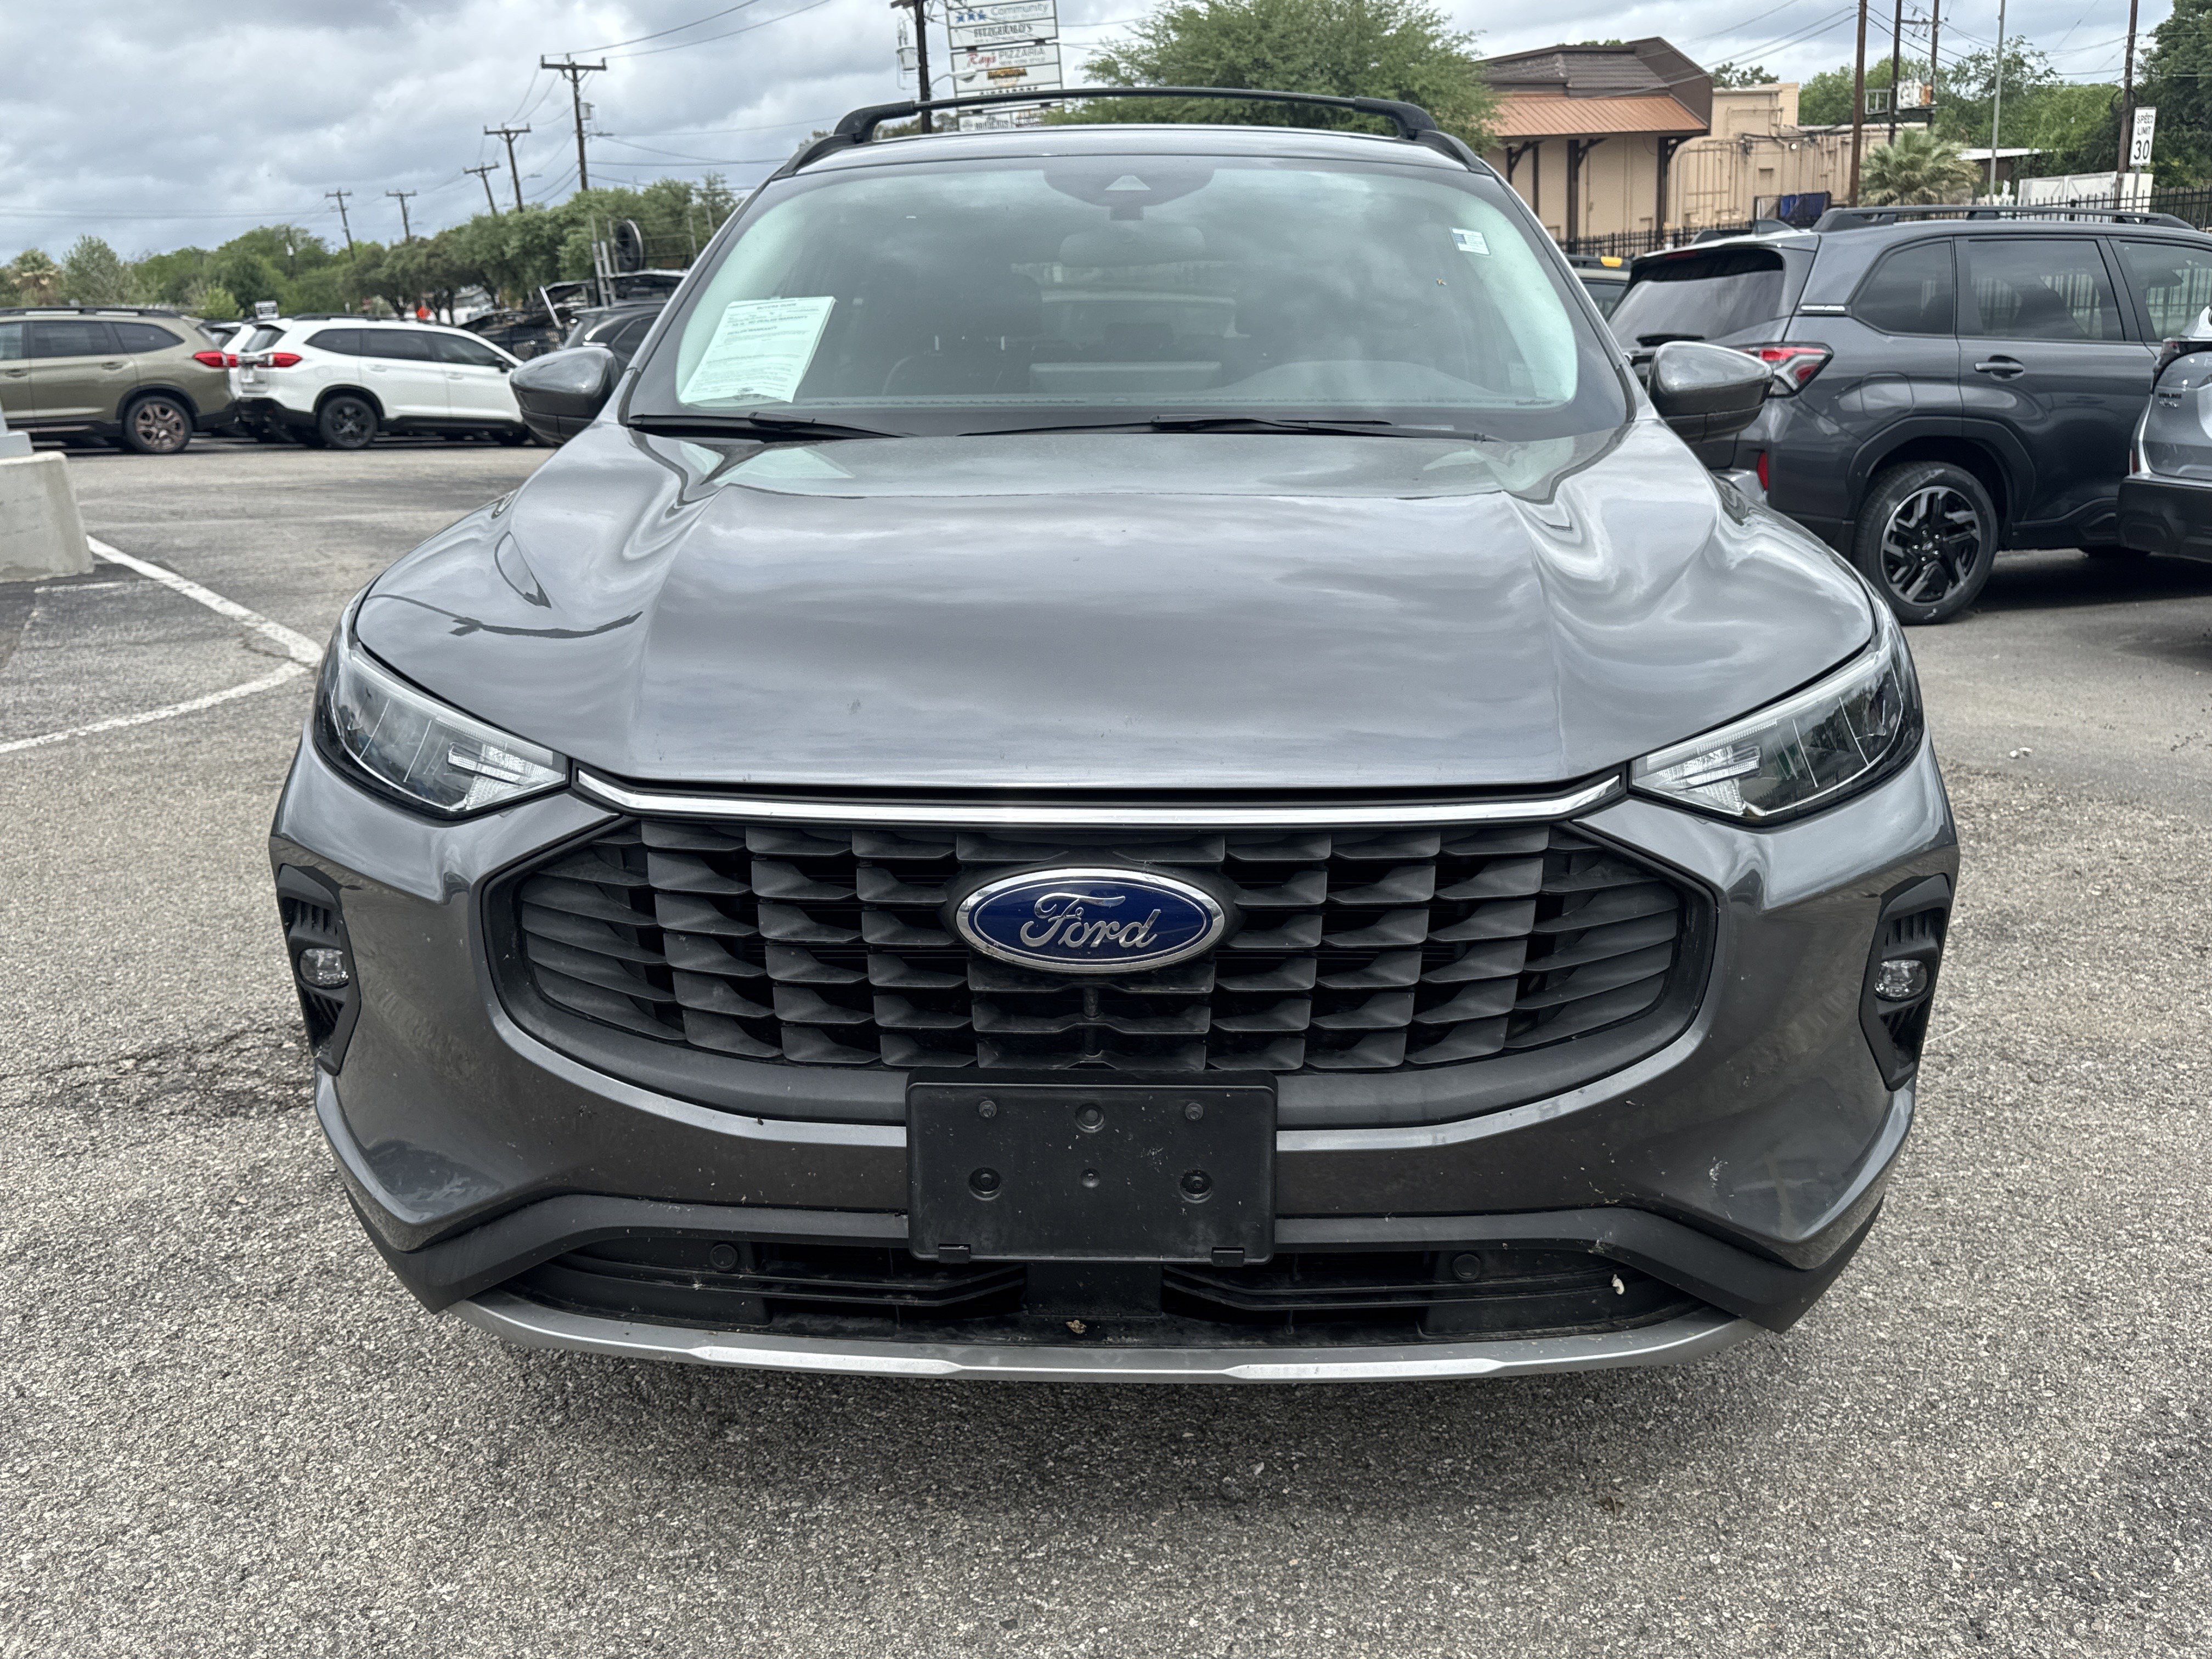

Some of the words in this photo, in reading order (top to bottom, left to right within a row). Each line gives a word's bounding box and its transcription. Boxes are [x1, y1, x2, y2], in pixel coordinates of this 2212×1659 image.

[990, 3, 1049, 15] Community
[2136, 115, 2153, 124] SPEED
[2137, 126, 2152, 136] LIMIT
[2134, 139, 2150, 160] 30
[1020, 892, 1162, 949] Ford
